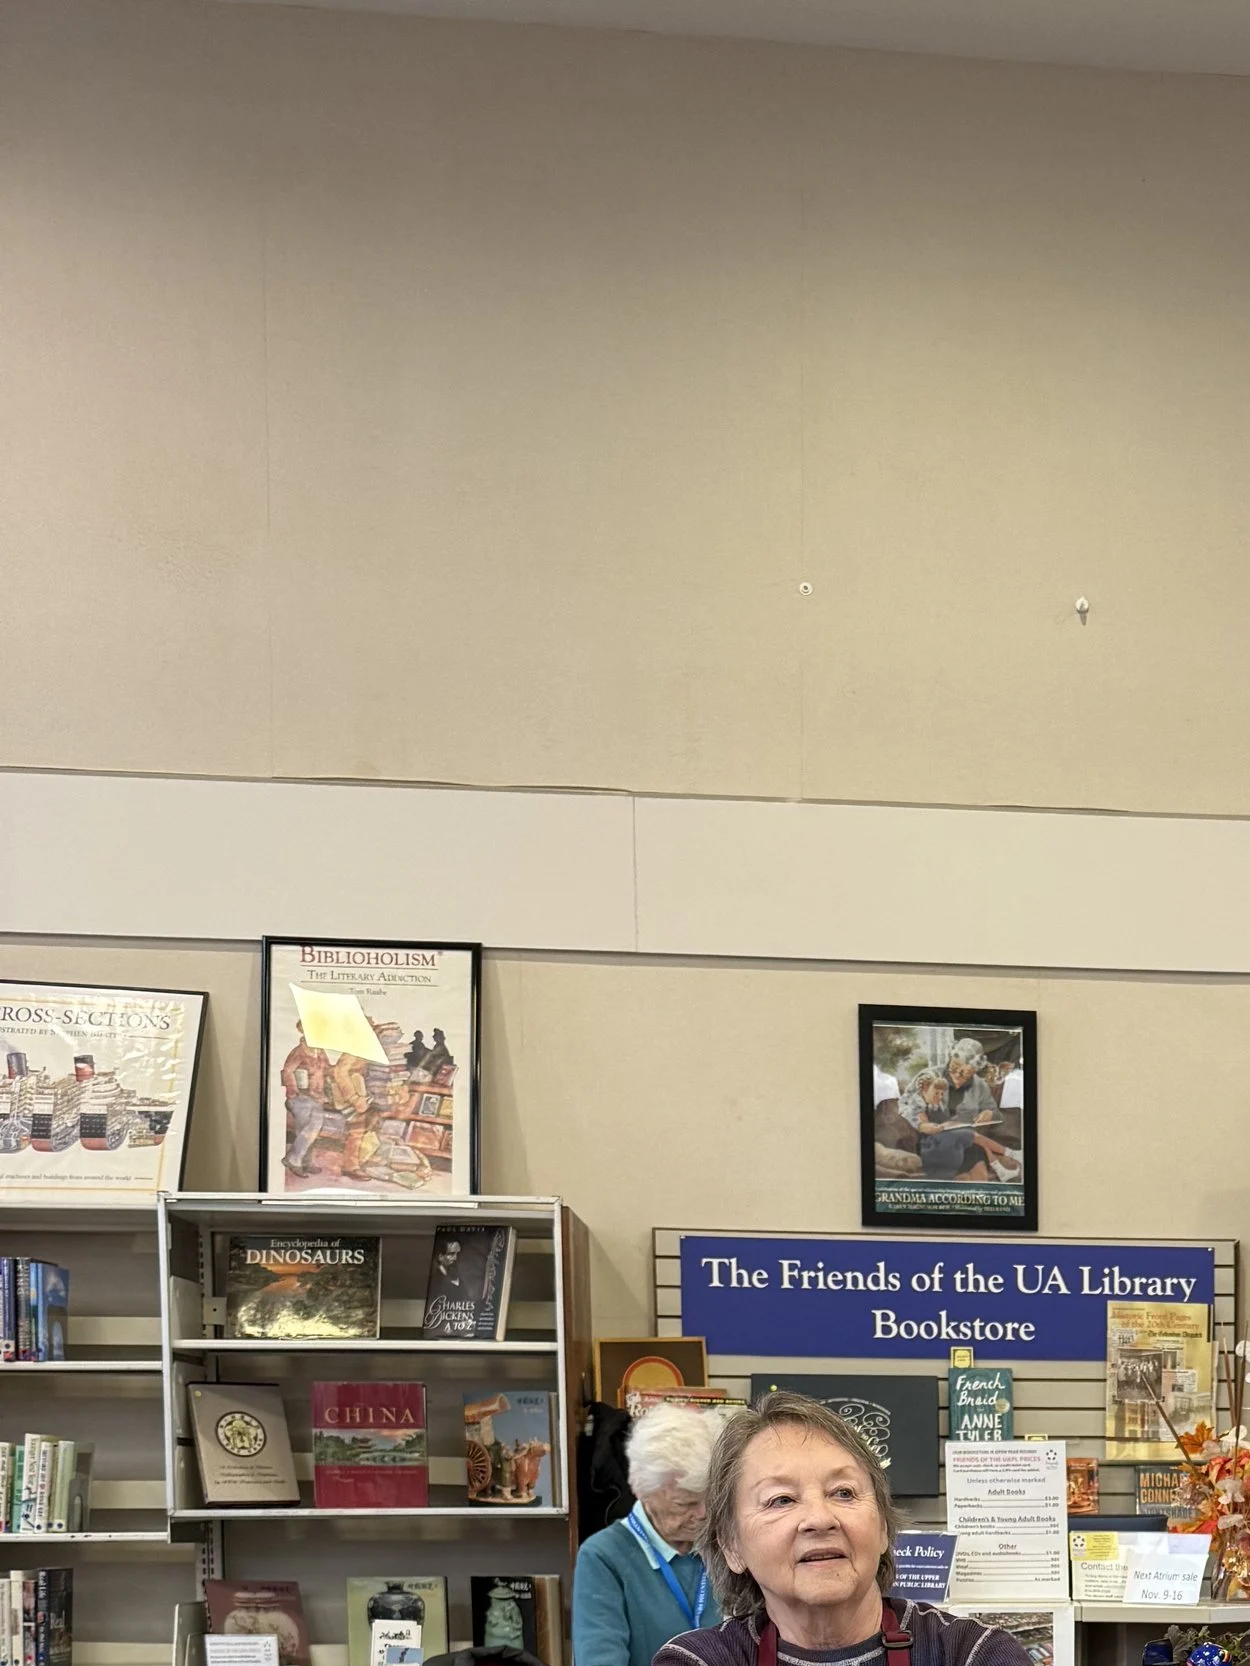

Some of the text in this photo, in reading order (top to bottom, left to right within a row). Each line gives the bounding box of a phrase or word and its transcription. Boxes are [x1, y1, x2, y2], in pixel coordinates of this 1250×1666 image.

[301, 945, 436, 967] BIBLIOHOLISM
[307, 970, 431, 983] THE LITERARY ADDICTION
[270, 1239, 340, 1250] Encyclopedia of
[245, 1249, 365, 1265] DINOSAURS
[701, 1257, 1198, 1303] The Friends of the UA Library
[872, 1309, 1036, 1342] Bookstore
[956, 1372, 1005, 1390] French
[957, 1391, 998, 1406] Braid
[324, 1407, 416, 1425] CHINA
[961, 1413, 1002, 1429] ANNE
[914, 1546, 945, 1560] Policy
[1134, 1571, 1198, 1582] Next Atrium sale
[1163, 1590, 1183, 1600] 9-16
